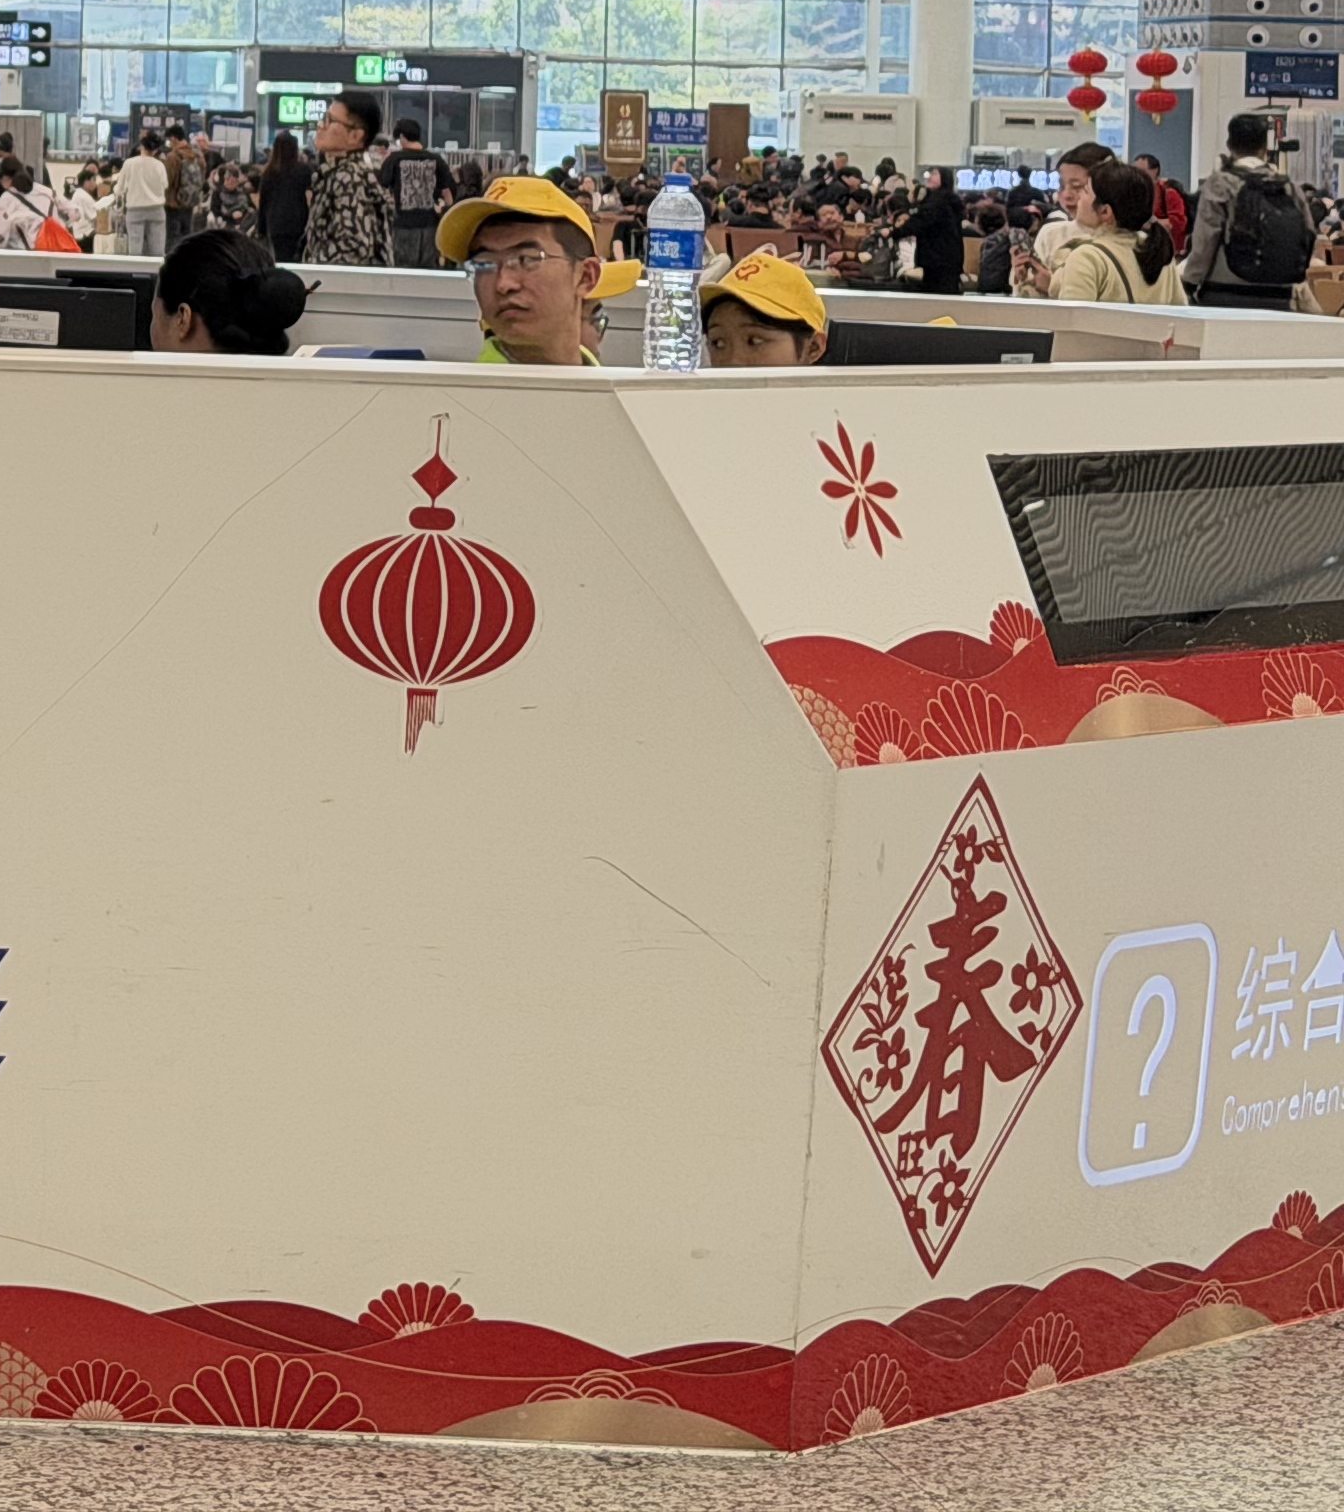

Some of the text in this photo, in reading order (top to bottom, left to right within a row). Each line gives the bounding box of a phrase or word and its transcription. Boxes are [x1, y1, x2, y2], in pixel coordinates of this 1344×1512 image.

[648, 110, 707, 128] 助办理
[874, 888, 1041, 1161] 春
